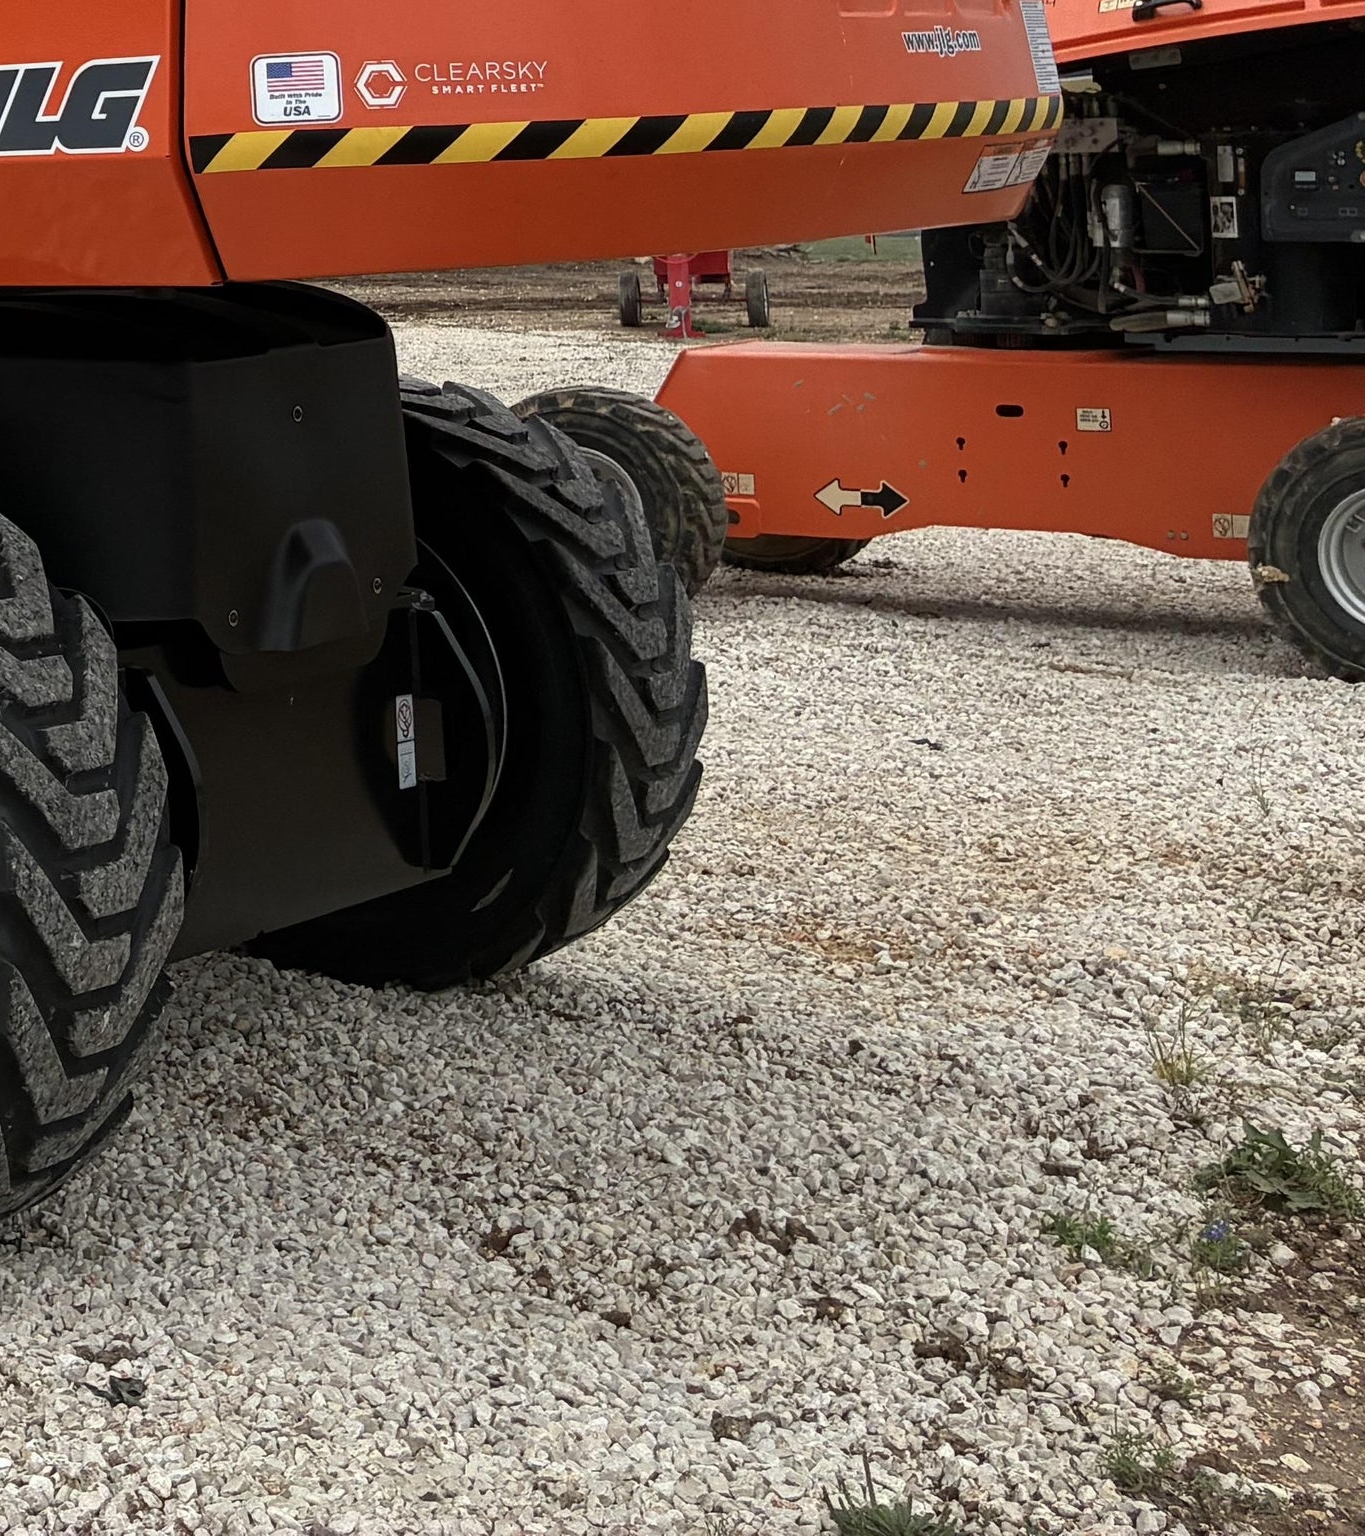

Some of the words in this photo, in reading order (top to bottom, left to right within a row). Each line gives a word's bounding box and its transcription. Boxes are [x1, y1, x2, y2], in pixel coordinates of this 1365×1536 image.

[902, 25, 981, 57] www.jlg.com
[415, 61, 548, 82] CLEARSKY
[432, 85, 484, 95] SMART
[283, 106, 311, 116] USA
